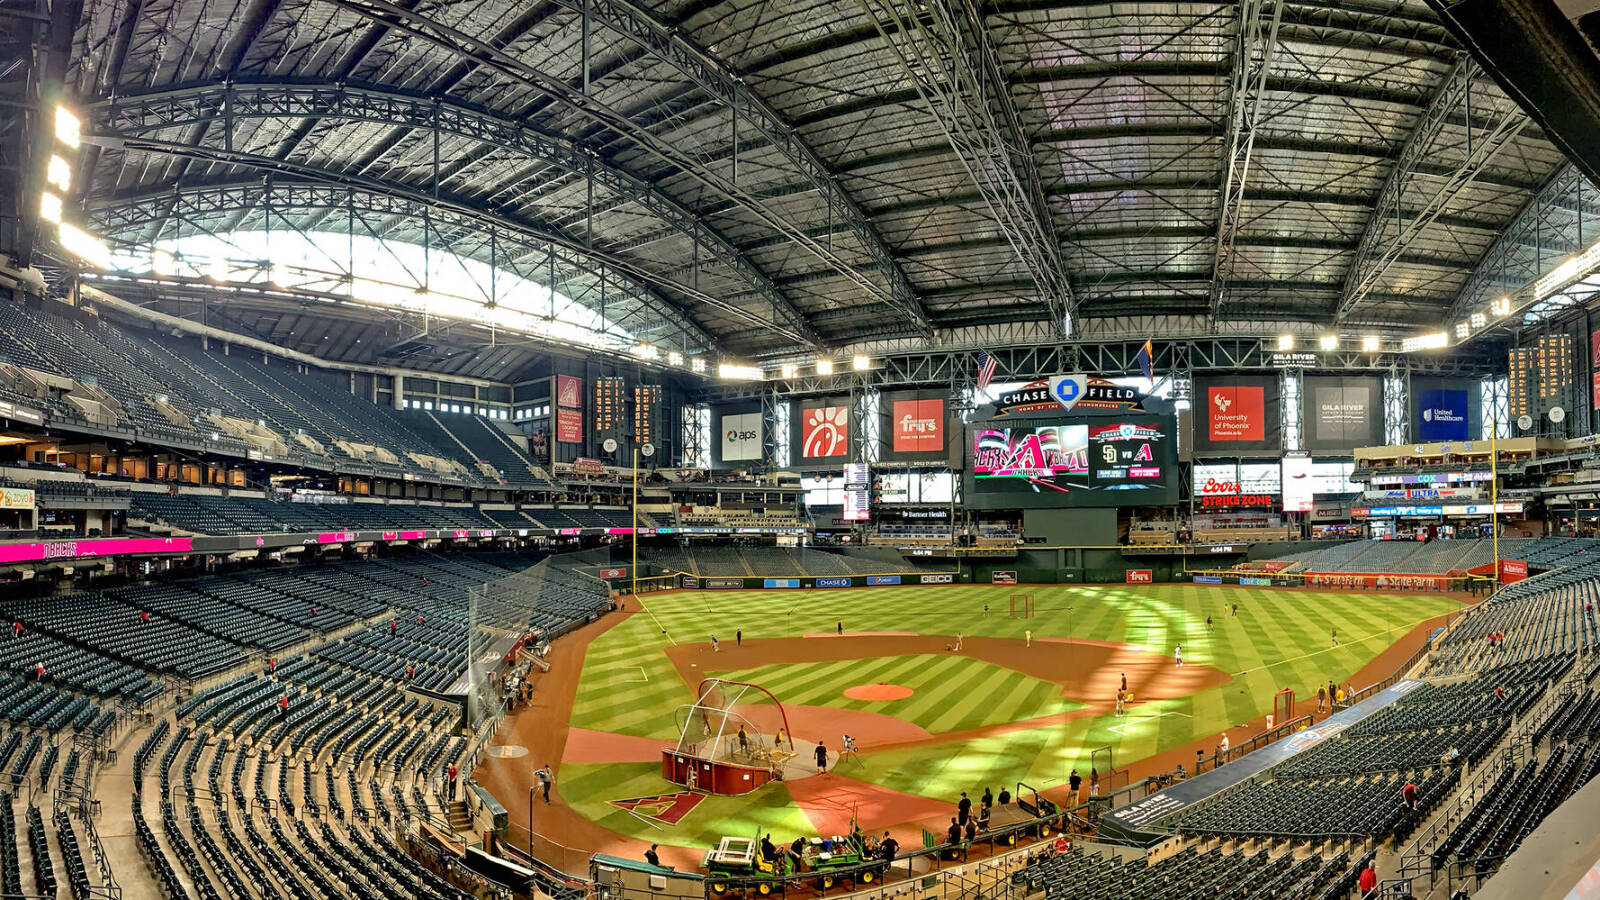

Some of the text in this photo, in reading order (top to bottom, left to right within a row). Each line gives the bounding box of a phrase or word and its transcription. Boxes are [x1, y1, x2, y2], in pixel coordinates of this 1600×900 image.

[1003, 388, 1134, 404] CHASE FIELD
[1214, 414, 1248, 422] University
[738, 430, 756, 440] aps
[1417, 474, 1436, 482] COX
[1202, 478, 1240, 493] Coors
[1202, 495, 1272, 506] STRIKE ZONE
[920, 575, 952, 584] GEICO
